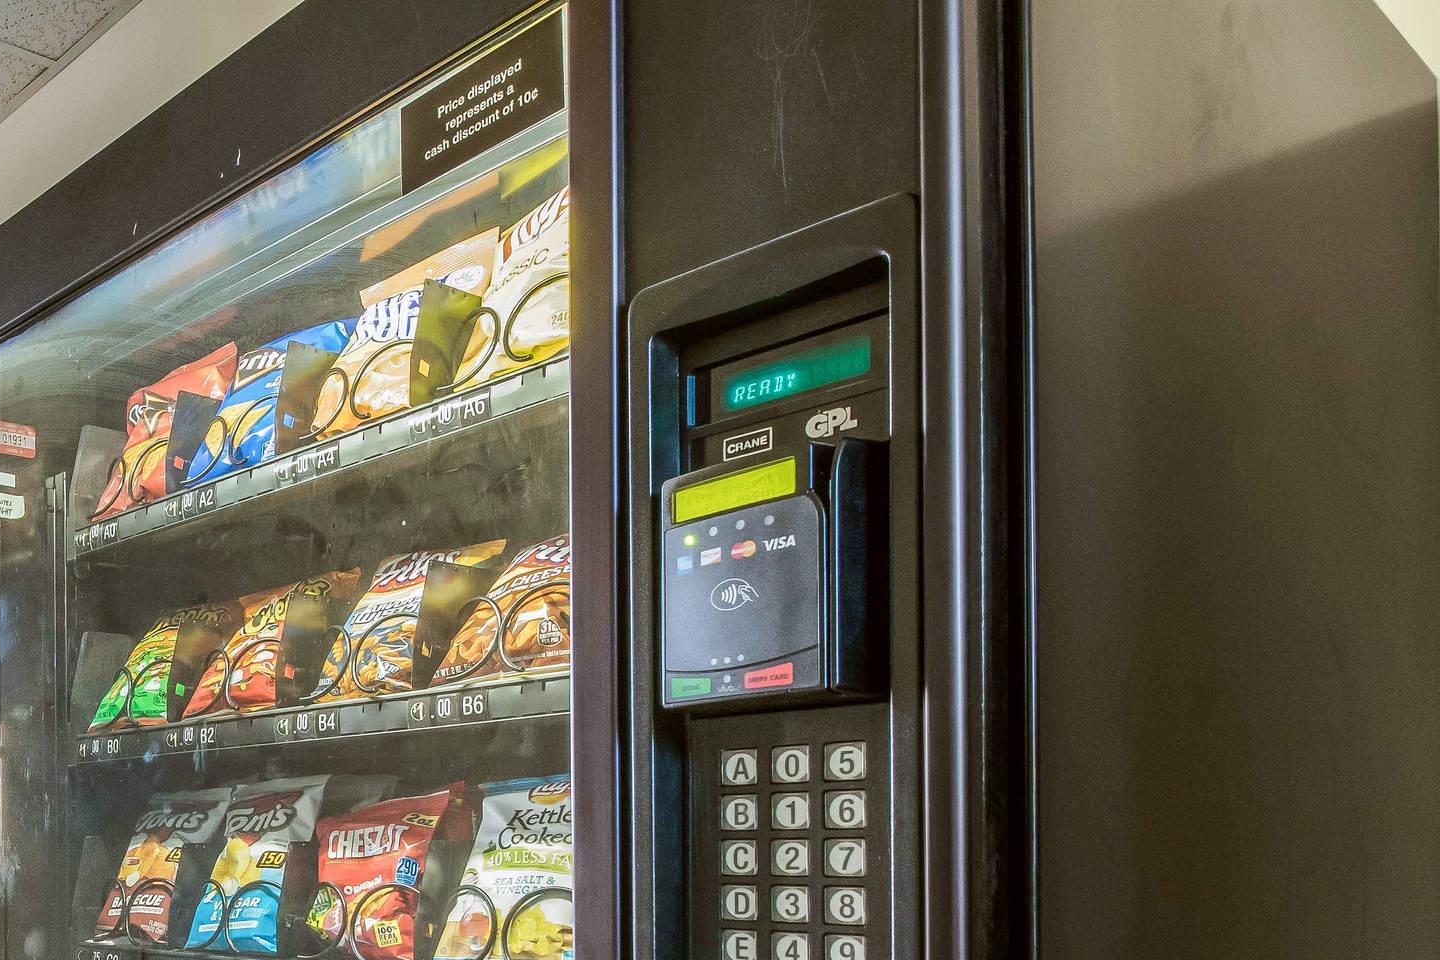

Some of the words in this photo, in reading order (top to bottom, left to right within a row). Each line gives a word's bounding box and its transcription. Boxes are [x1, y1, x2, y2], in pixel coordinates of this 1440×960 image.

[437, 97, 464, 118] Price
[467, 58, 522, 101] displayed
[445, 91, 504, 131] represents
[506, 83, 514, 96] a
[425, 138, 449, 161] cash
[452, 110, 500, 145] discount
[502, 100, 514, 119] of
[517, 88, 539, 107] 10¢
[734, 373, 796, 403] READY
[464, 399, 485, 419] A6
[805, 406, 858, 438] GPL
[726, 436, 769, 455] CRANE
[317, 451, 335, 468] A4
[199, 491, 213, 505] A2
[103, 523, 116, 539] A0
[762, 535, 796, 551] VISA
[462, 694, 484, 715] B6
[318, 713, 336, 731] B4
[200, 727, 215, 744] B2
[107, 740, 118, 754] B0
[732, 757, 749, 780] A
[785, 754, 799, 777] 0
[839, 751, 854, 774] 5
[734, 803, 749, 825] B
[785, 801, 796, 824] 1
[839, 798, 855, 823] 6
[260, 852, 286, 865] 150
[397, 858, 418, 876] 290
[487, 851, 511, 867] 40%
[515, 850, 546, 864] LESS
[733, 847, 749, 870] C
[785, 847, 800, 870] 2
[839, 847, 855, 870] 7
[515, 875, 543, 885] SALT
[547, 876, 555, 885] &
[734, 892, 750, 914] D
[785, 893, 799, 916] 3
[839, 894, 855, 918] 8
[380, 933, 397, 941] REAL
[735, 937, 749, 960] E
